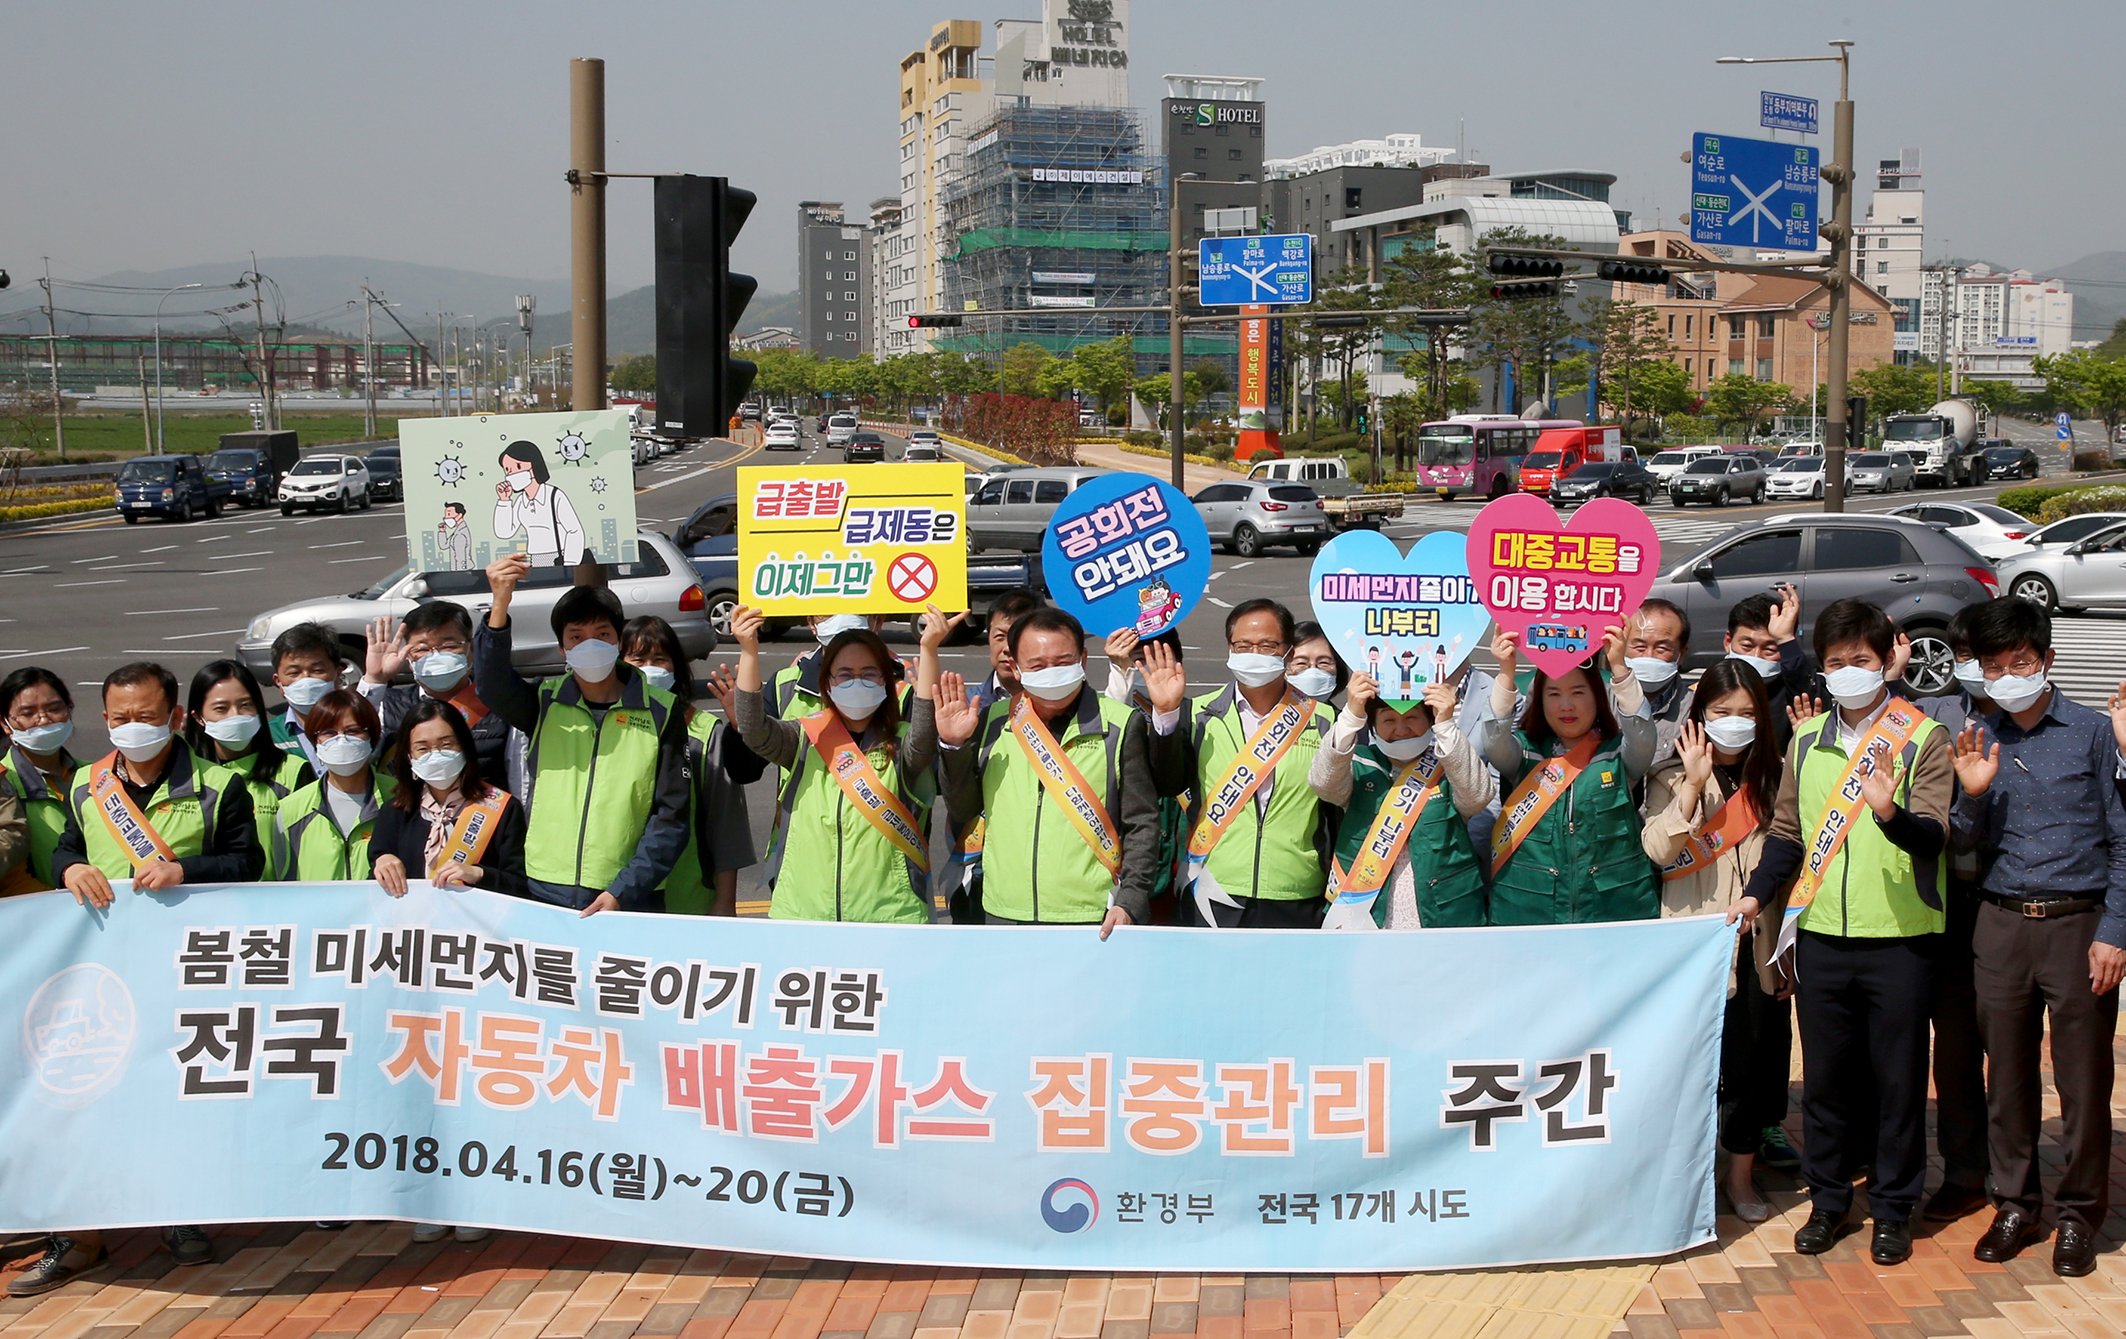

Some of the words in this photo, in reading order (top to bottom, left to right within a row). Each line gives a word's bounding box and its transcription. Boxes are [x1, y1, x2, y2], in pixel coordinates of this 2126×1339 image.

[1218, 108, 1260, 123] HOTEL
[1698, 154, 1725, 172] 여순로
[1698, 171, 1725, 184] Yeosun-ro
[1784, 164, 1816, 183] 남승룡로
[1696, 229, 1721, 240] Gasan-ro
[1697, 212, 1723, 228] 가산로
[1786, 219, 1810, 235] 팔마로
[1243, 249, 1265, 259] 팔마로
[1282, 250, 1305, 260] 백강로
[1785, 235, 1808, 246] Palma-ro
[1202, 263, 1231, 274] 남승룡로
[1282, 284, 1304, 293] 가산로
[1246, 348, 1259, 404] 행복도시
[756, 480, 844, 517] 급출발
[846, 510, 956, 542] 급제동은
[1058, 486, 1166, 558] 공회전
[1074, 530, 1184, 601] 안돼요
[1493, 532, 1640, 573] 대중교통을
[756, 562, 873, 598] 이제그만
[1492, 576, 1548, 611] 이용
[1554, 583, 1622, 612] 합시다
[1366, 609, 1440, 636] 나부터
[1254, 705, 1300, 761] 공회전
[1207, 766, 1254, 824] 안돼요
[1372, 816, 1404, 859] 나부터
[1810, 809, 1846, 875] 안돼요
[180, 929, 292, 986] 봄철
[314, 928, 577, 1006] 미세먼지를
[595, 956, 754, 1024] 줄이기
[774, 968, 884, 1032] 위한
[176, 1007, 348, 1095] 전국
[387, 1011, 630, 1116] 자동차
[664, 1044, 990, 1144] 배출가스
[1032, 1057, 1390, 1154] 집중관리
[1445, 1053, 1615, 1146] 주간
[321, 1132, 854, 1218] 2018.04.16(월)~20(금)
[1116, 1192, 1214, 1224] 환경부
[1258, 1192, 1320, 1224] 전국
[1331, 1190, 1396, 1225] 17개
[1408, 1188, 1470, 1223] 시도
